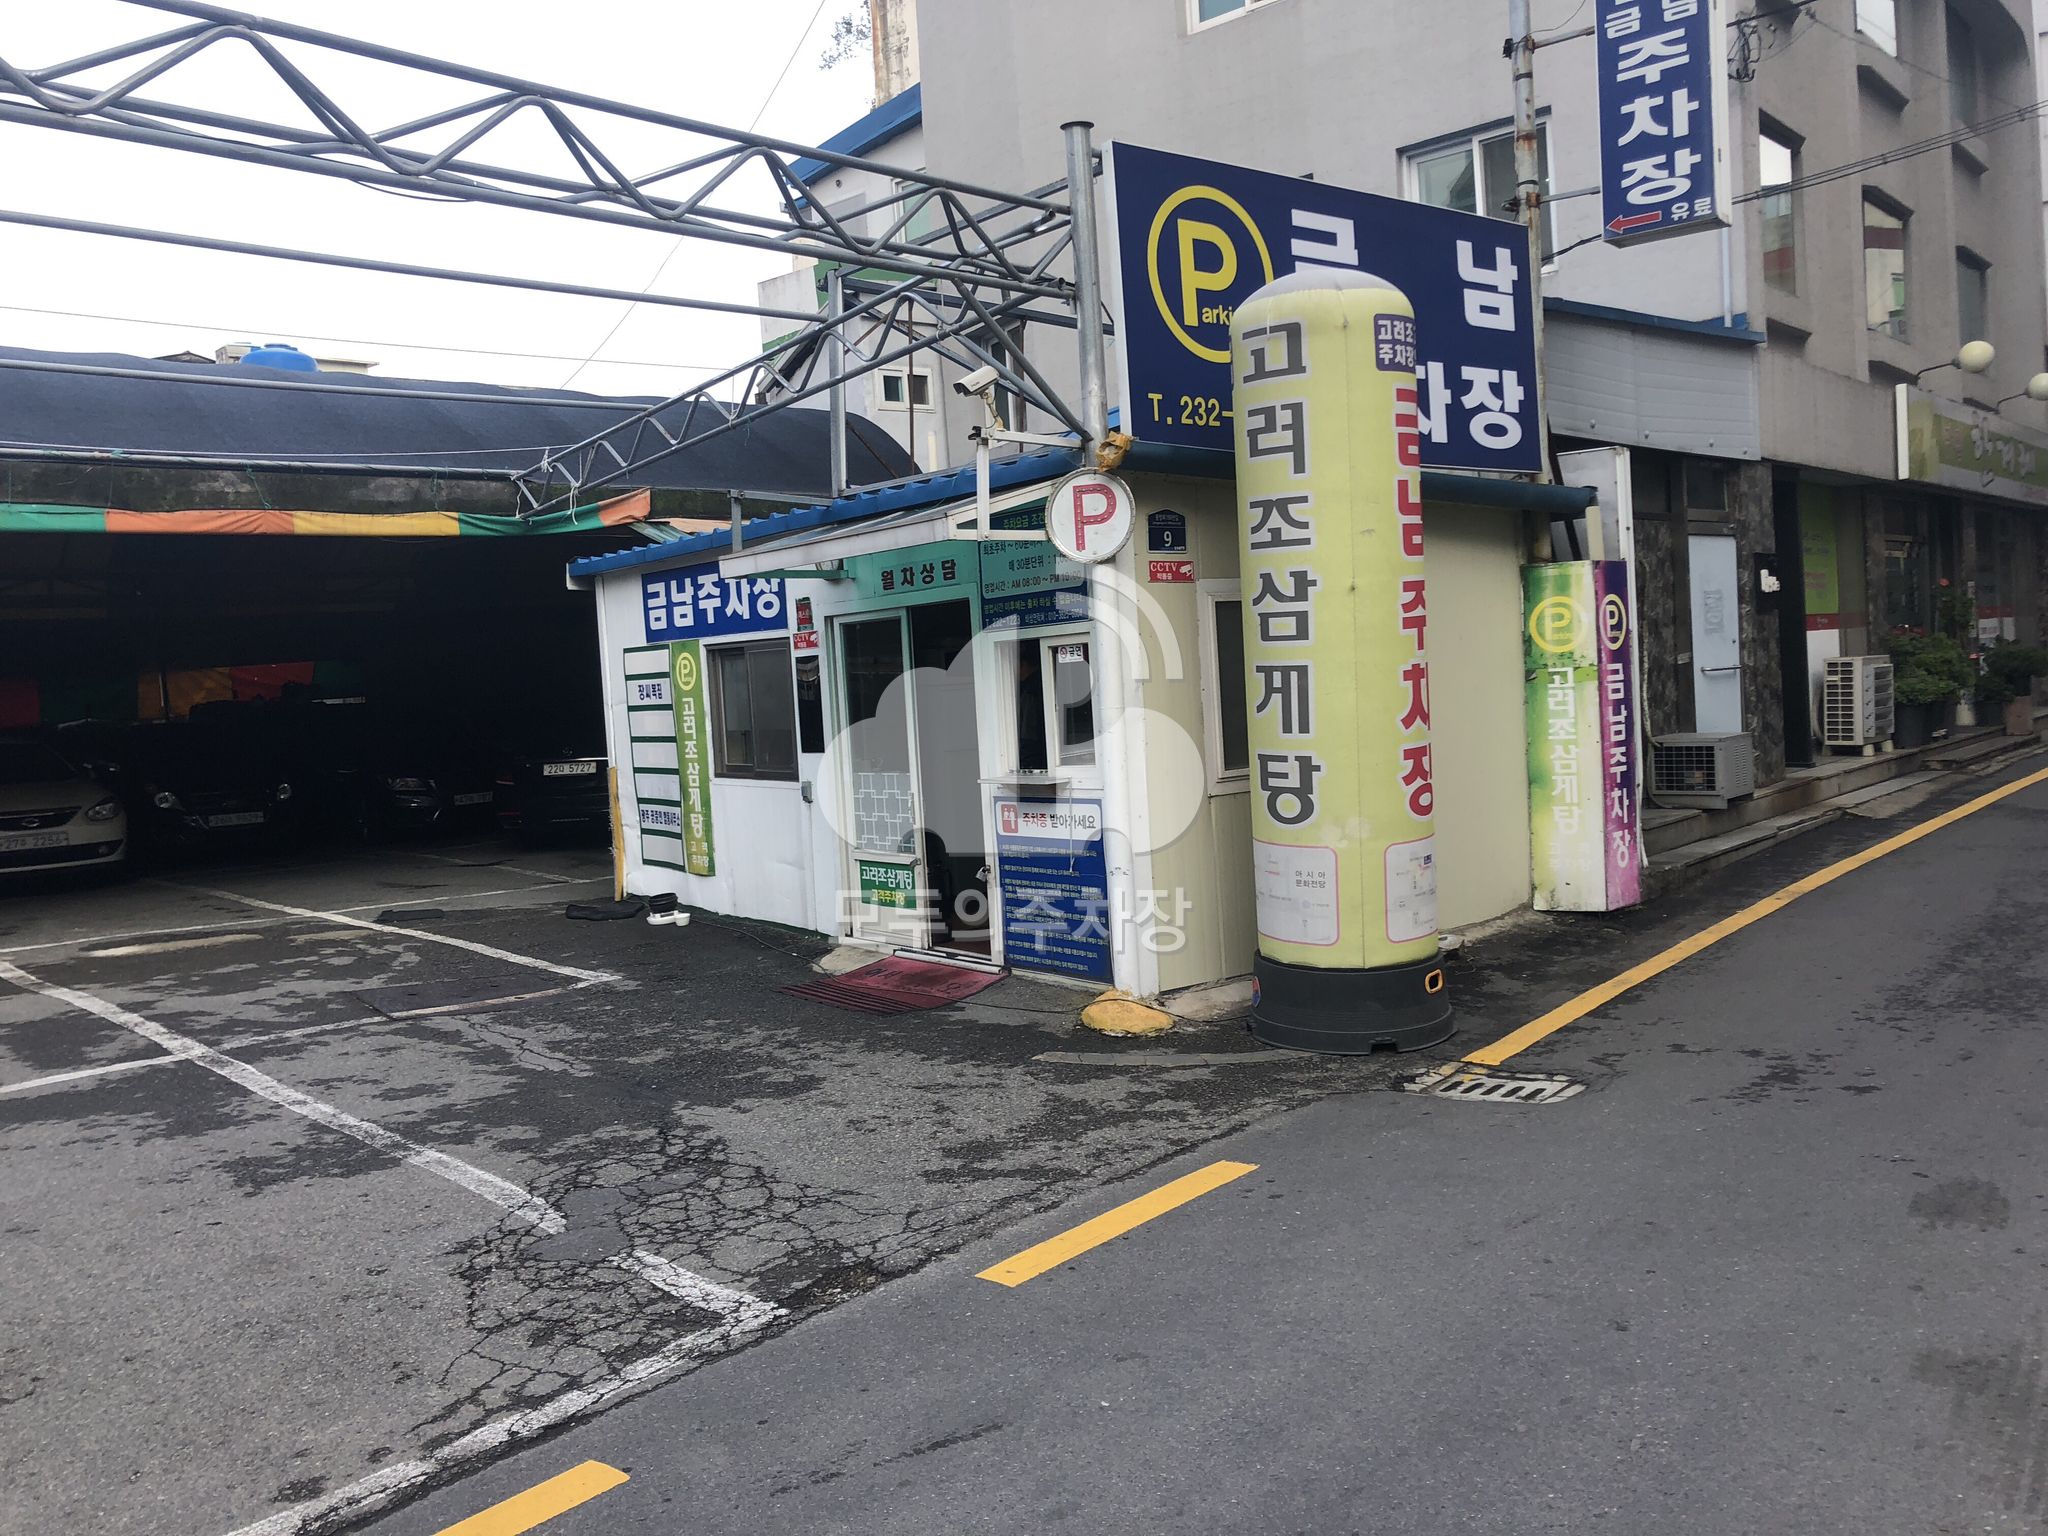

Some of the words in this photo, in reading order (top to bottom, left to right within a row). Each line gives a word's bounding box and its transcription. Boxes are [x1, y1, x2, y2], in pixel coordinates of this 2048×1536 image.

[1616, 28, 1702, 205] 주차장
[1671, 197, 1712, 220] 유료
[1377, 319, 1416, 345] 고려조
[1072, 483, 1117, 552] P
[1163, 530, 1173, 548] 9
[881, 559, 957, 591] 월차상담
[1150, 562, 1178, 572] CCTV
[1069, 645, 1081, 657] 금연
[568, 763, 592, 773] 5727
[1606, 663, 1632, 869] 금남주차장
